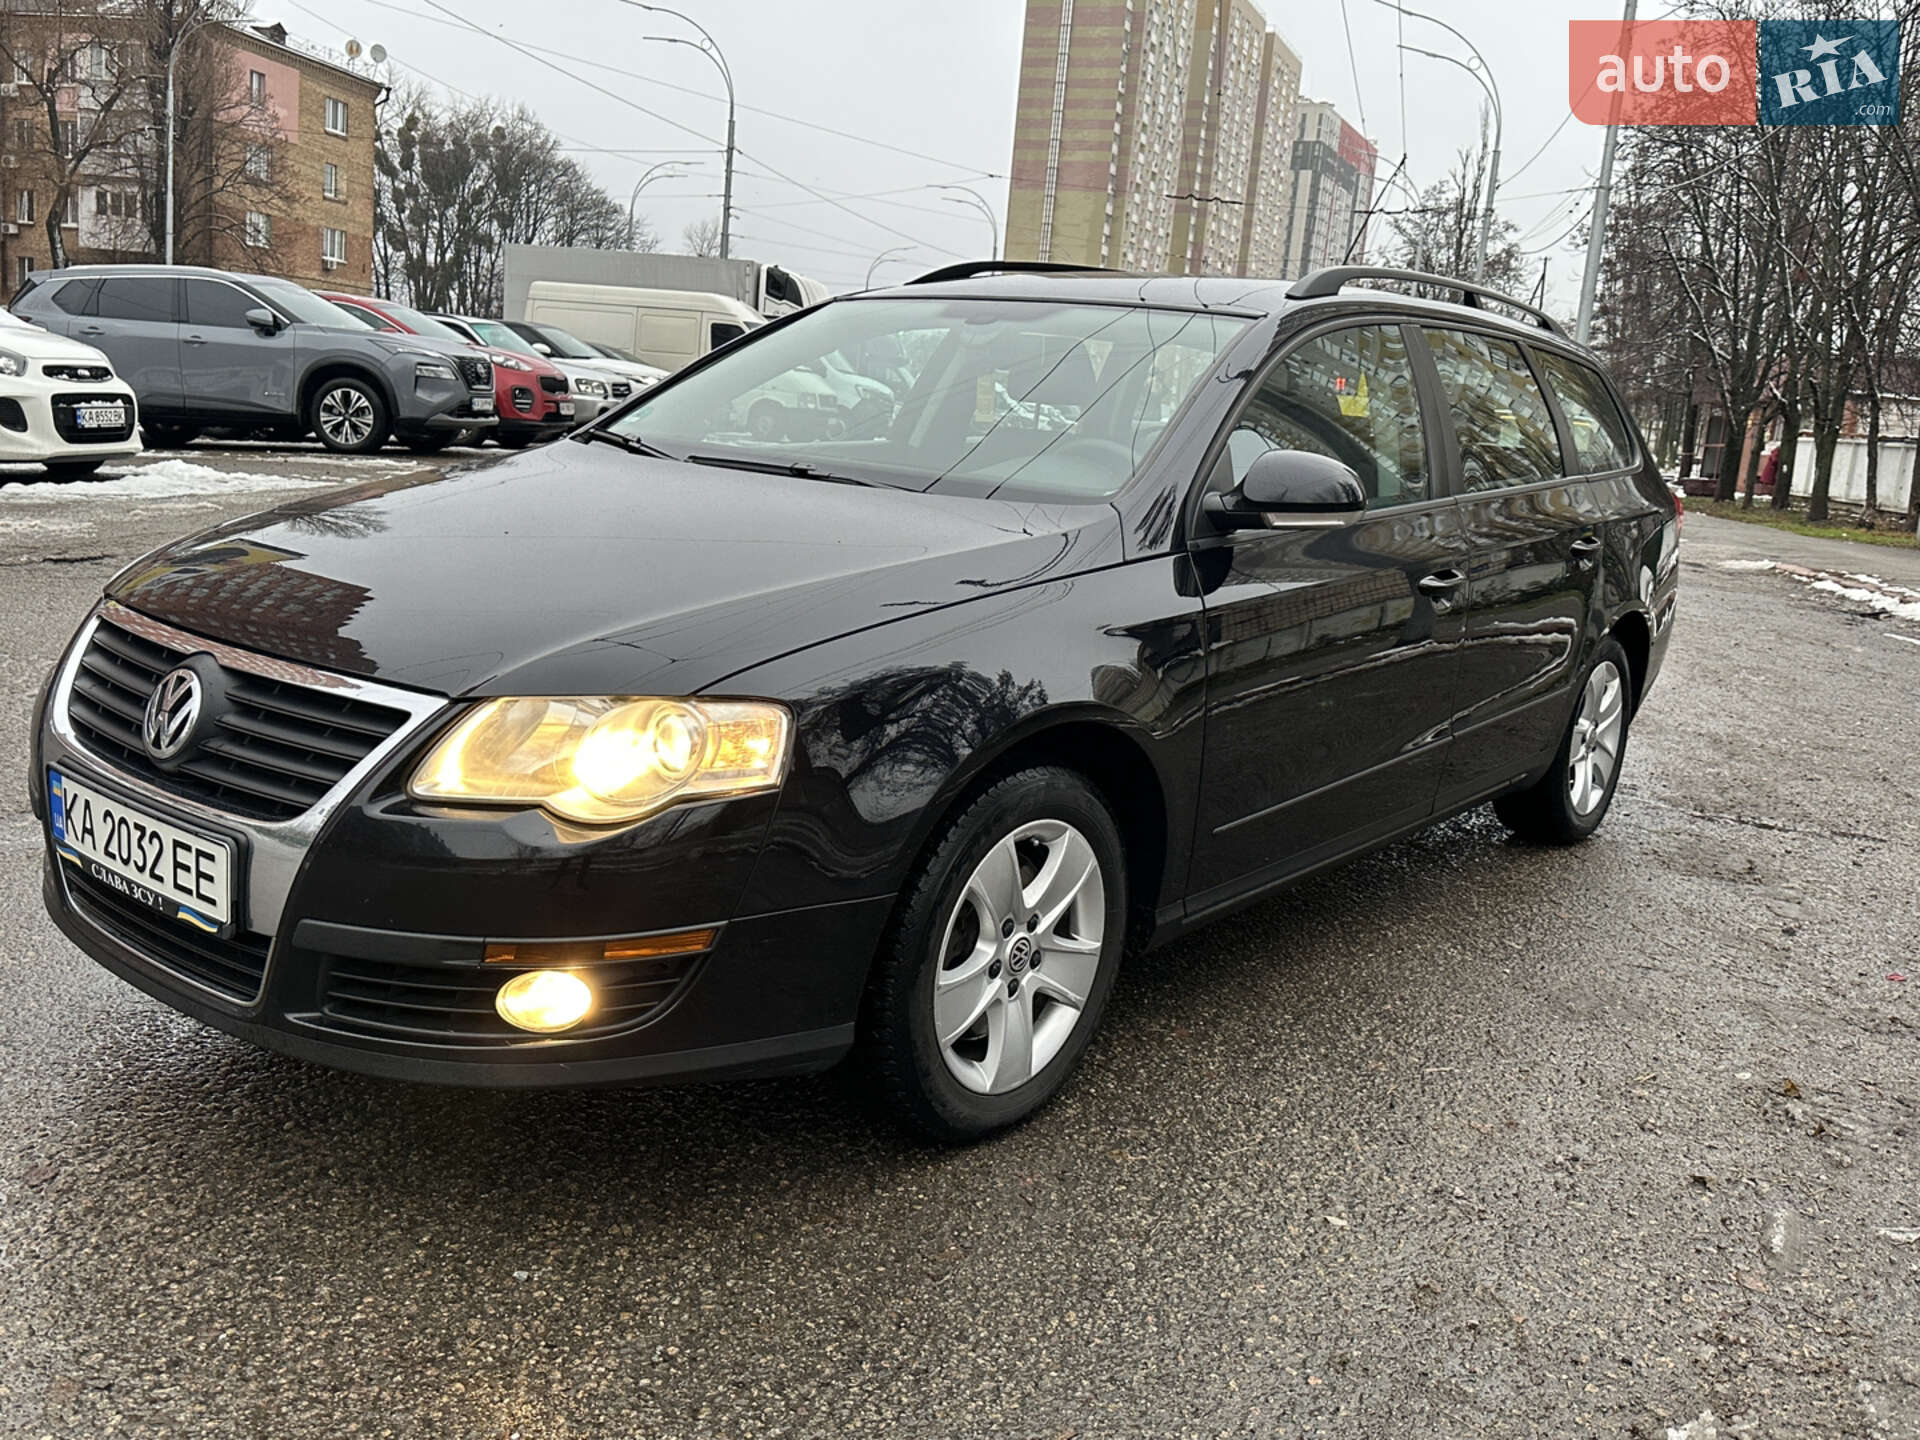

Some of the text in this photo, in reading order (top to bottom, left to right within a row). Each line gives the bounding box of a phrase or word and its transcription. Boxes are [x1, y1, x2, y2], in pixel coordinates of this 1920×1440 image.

[63, 787, 217, 907] KA 2032 EE
[91, 863, 130, 893] СЛАВА
